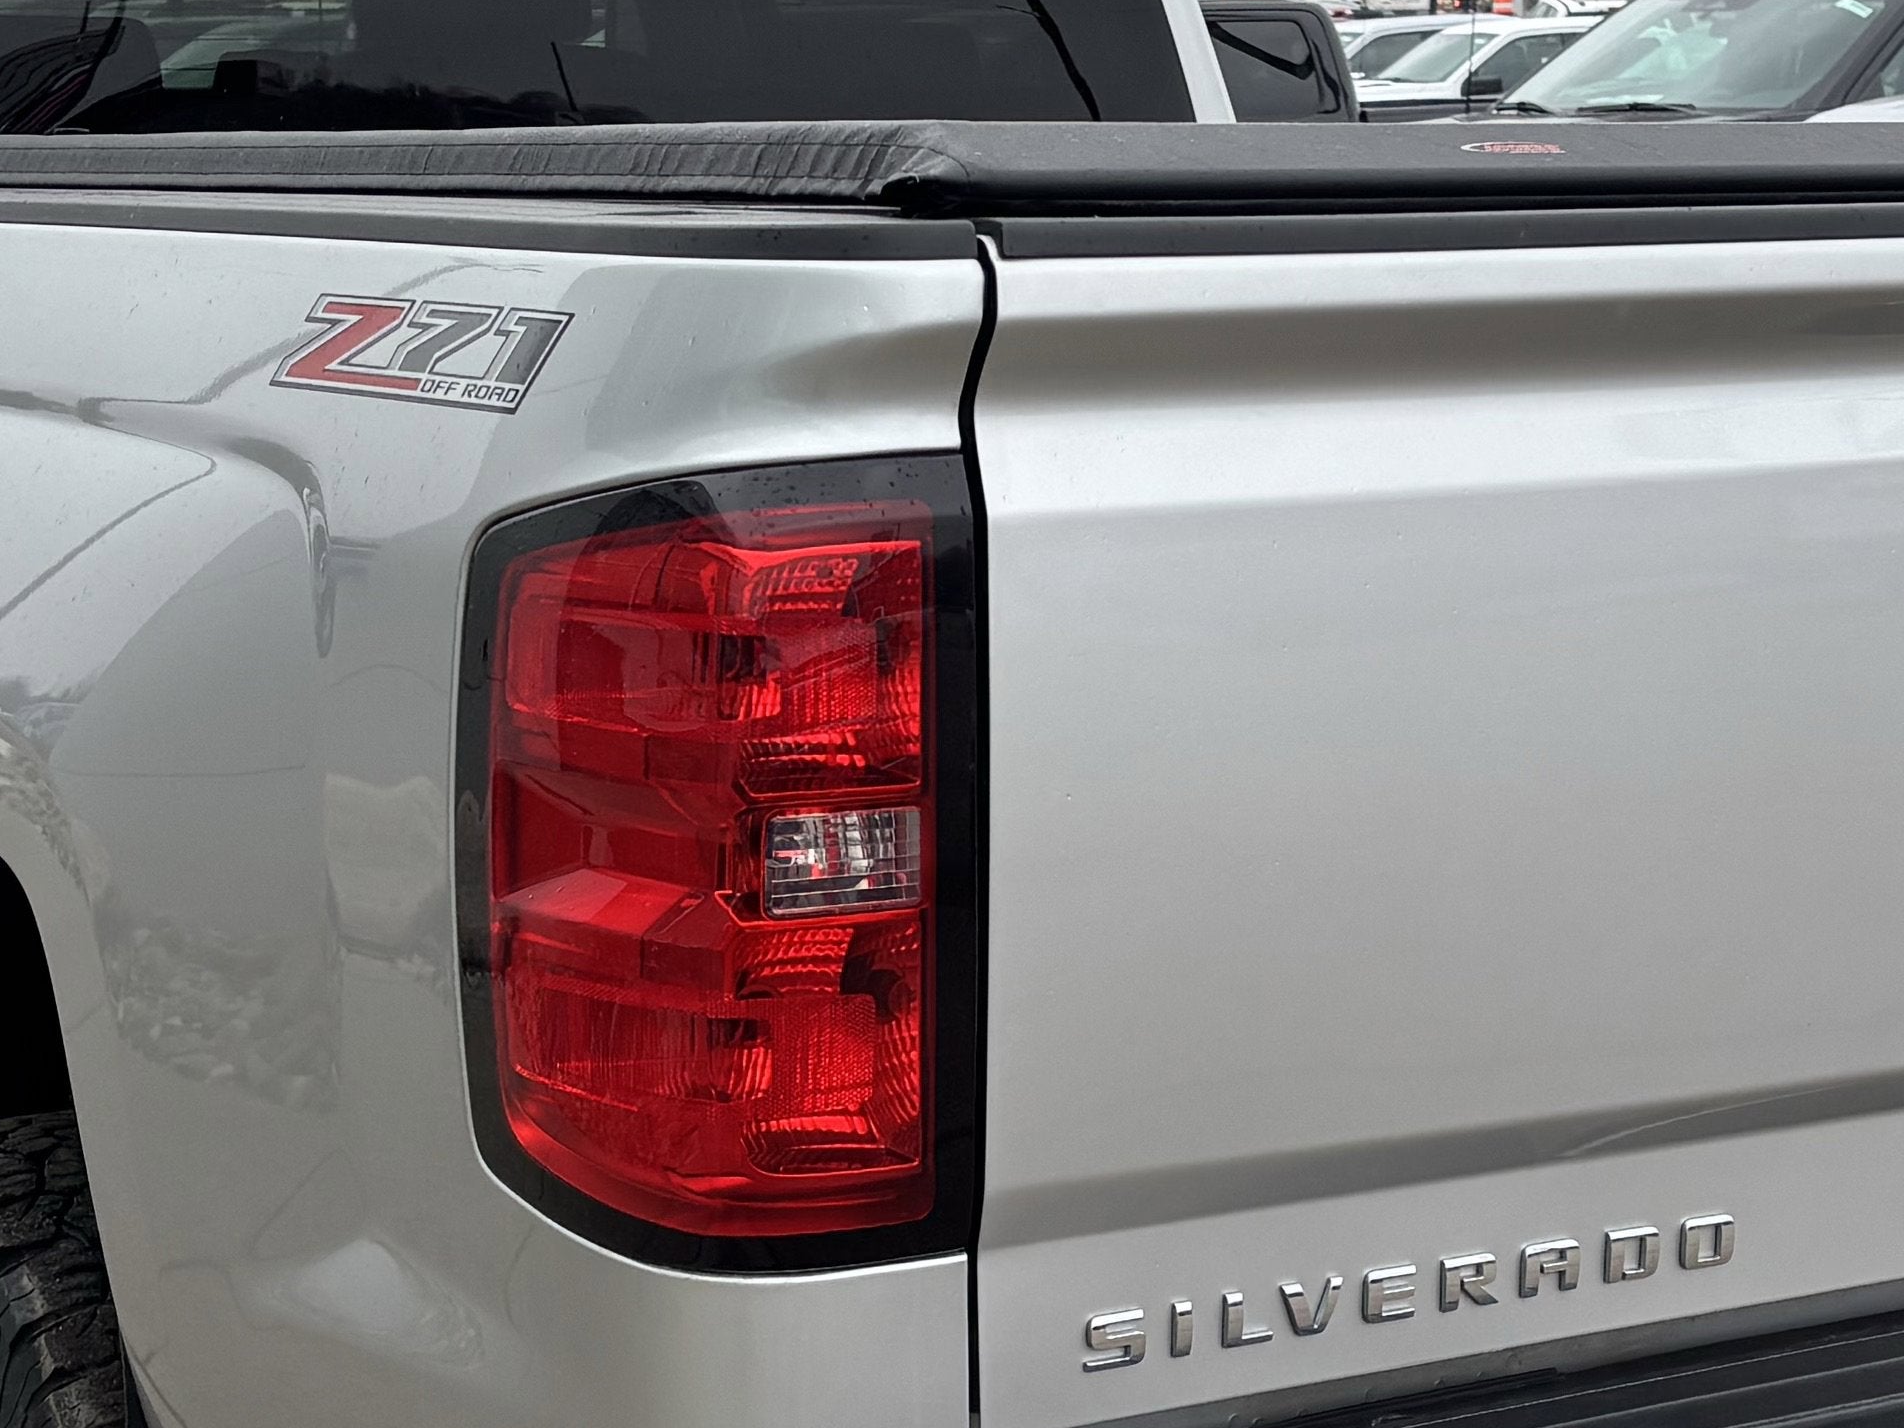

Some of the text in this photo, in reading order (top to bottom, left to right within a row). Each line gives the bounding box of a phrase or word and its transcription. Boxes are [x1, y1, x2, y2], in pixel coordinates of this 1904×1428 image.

[269, 293, 575, 415] Z71
[420, 378, 520, 404] OFF ROAD
[1082, 1212, 1735, 1372] SILVERADO
